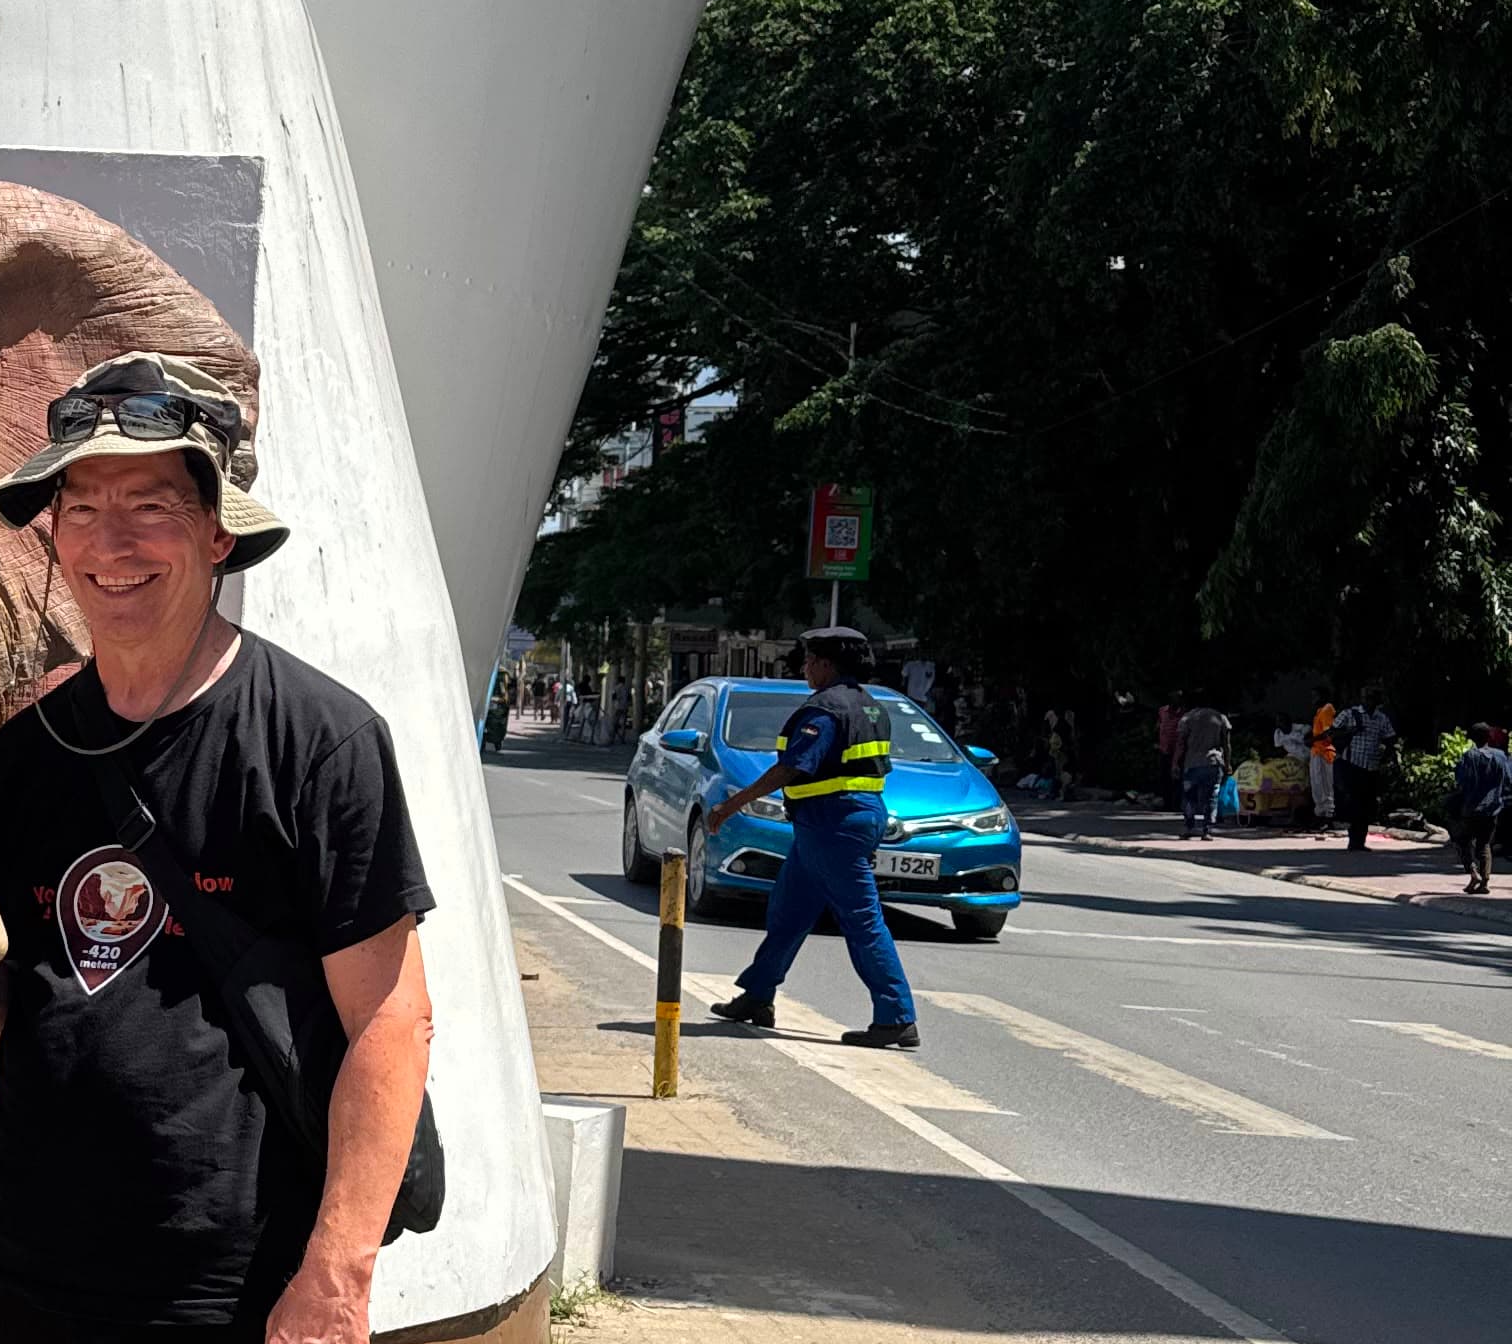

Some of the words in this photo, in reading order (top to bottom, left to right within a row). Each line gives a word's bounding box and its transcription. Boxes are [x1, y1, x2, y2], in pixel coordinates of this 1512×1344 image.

[890, 856, 935, 876] 152R
[82, 944, 121, 960] -420
[79, 959, 118, 970] meters
